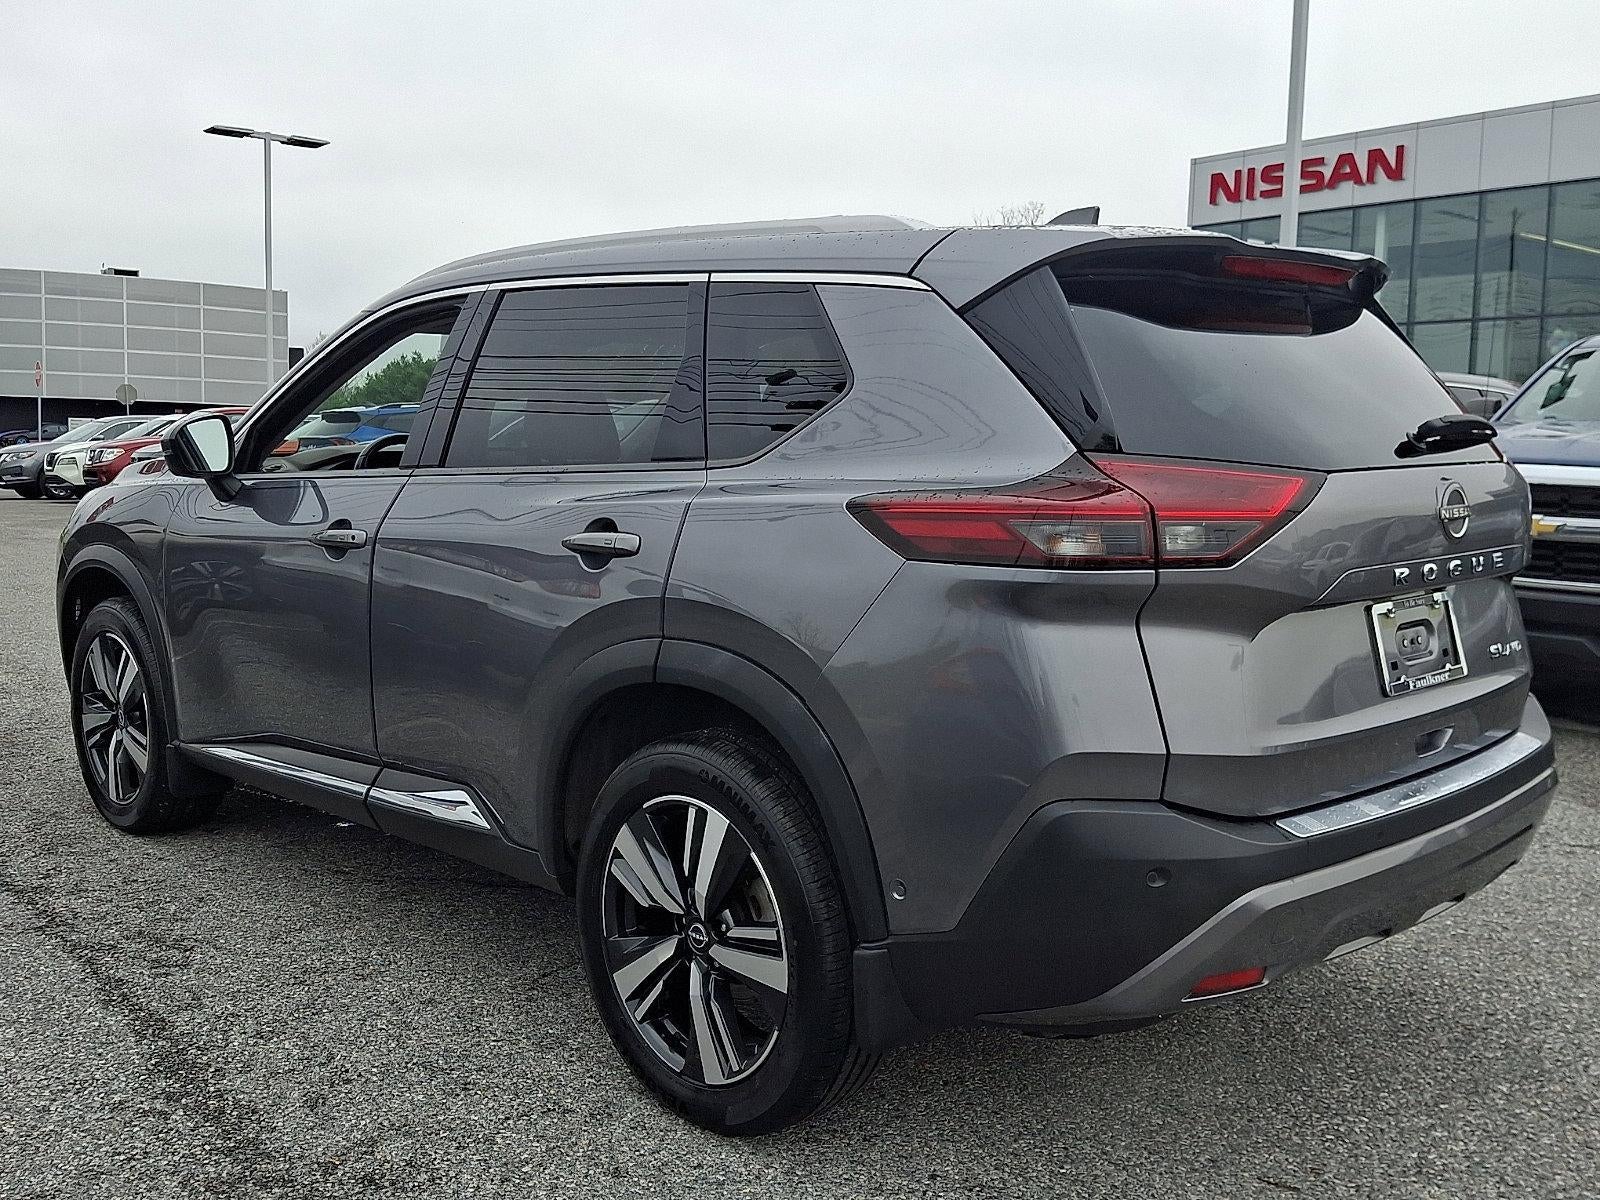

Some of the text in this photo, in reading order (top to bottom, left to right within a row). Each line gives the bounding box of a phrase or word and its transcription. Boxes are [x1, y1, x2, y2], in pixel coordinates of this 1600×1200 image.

[1209, 145, 1405, 206] NISSAN
[1393, 551, 1504, 586] ROGUE
[1409, 671, 1450, 690] Faulkner
